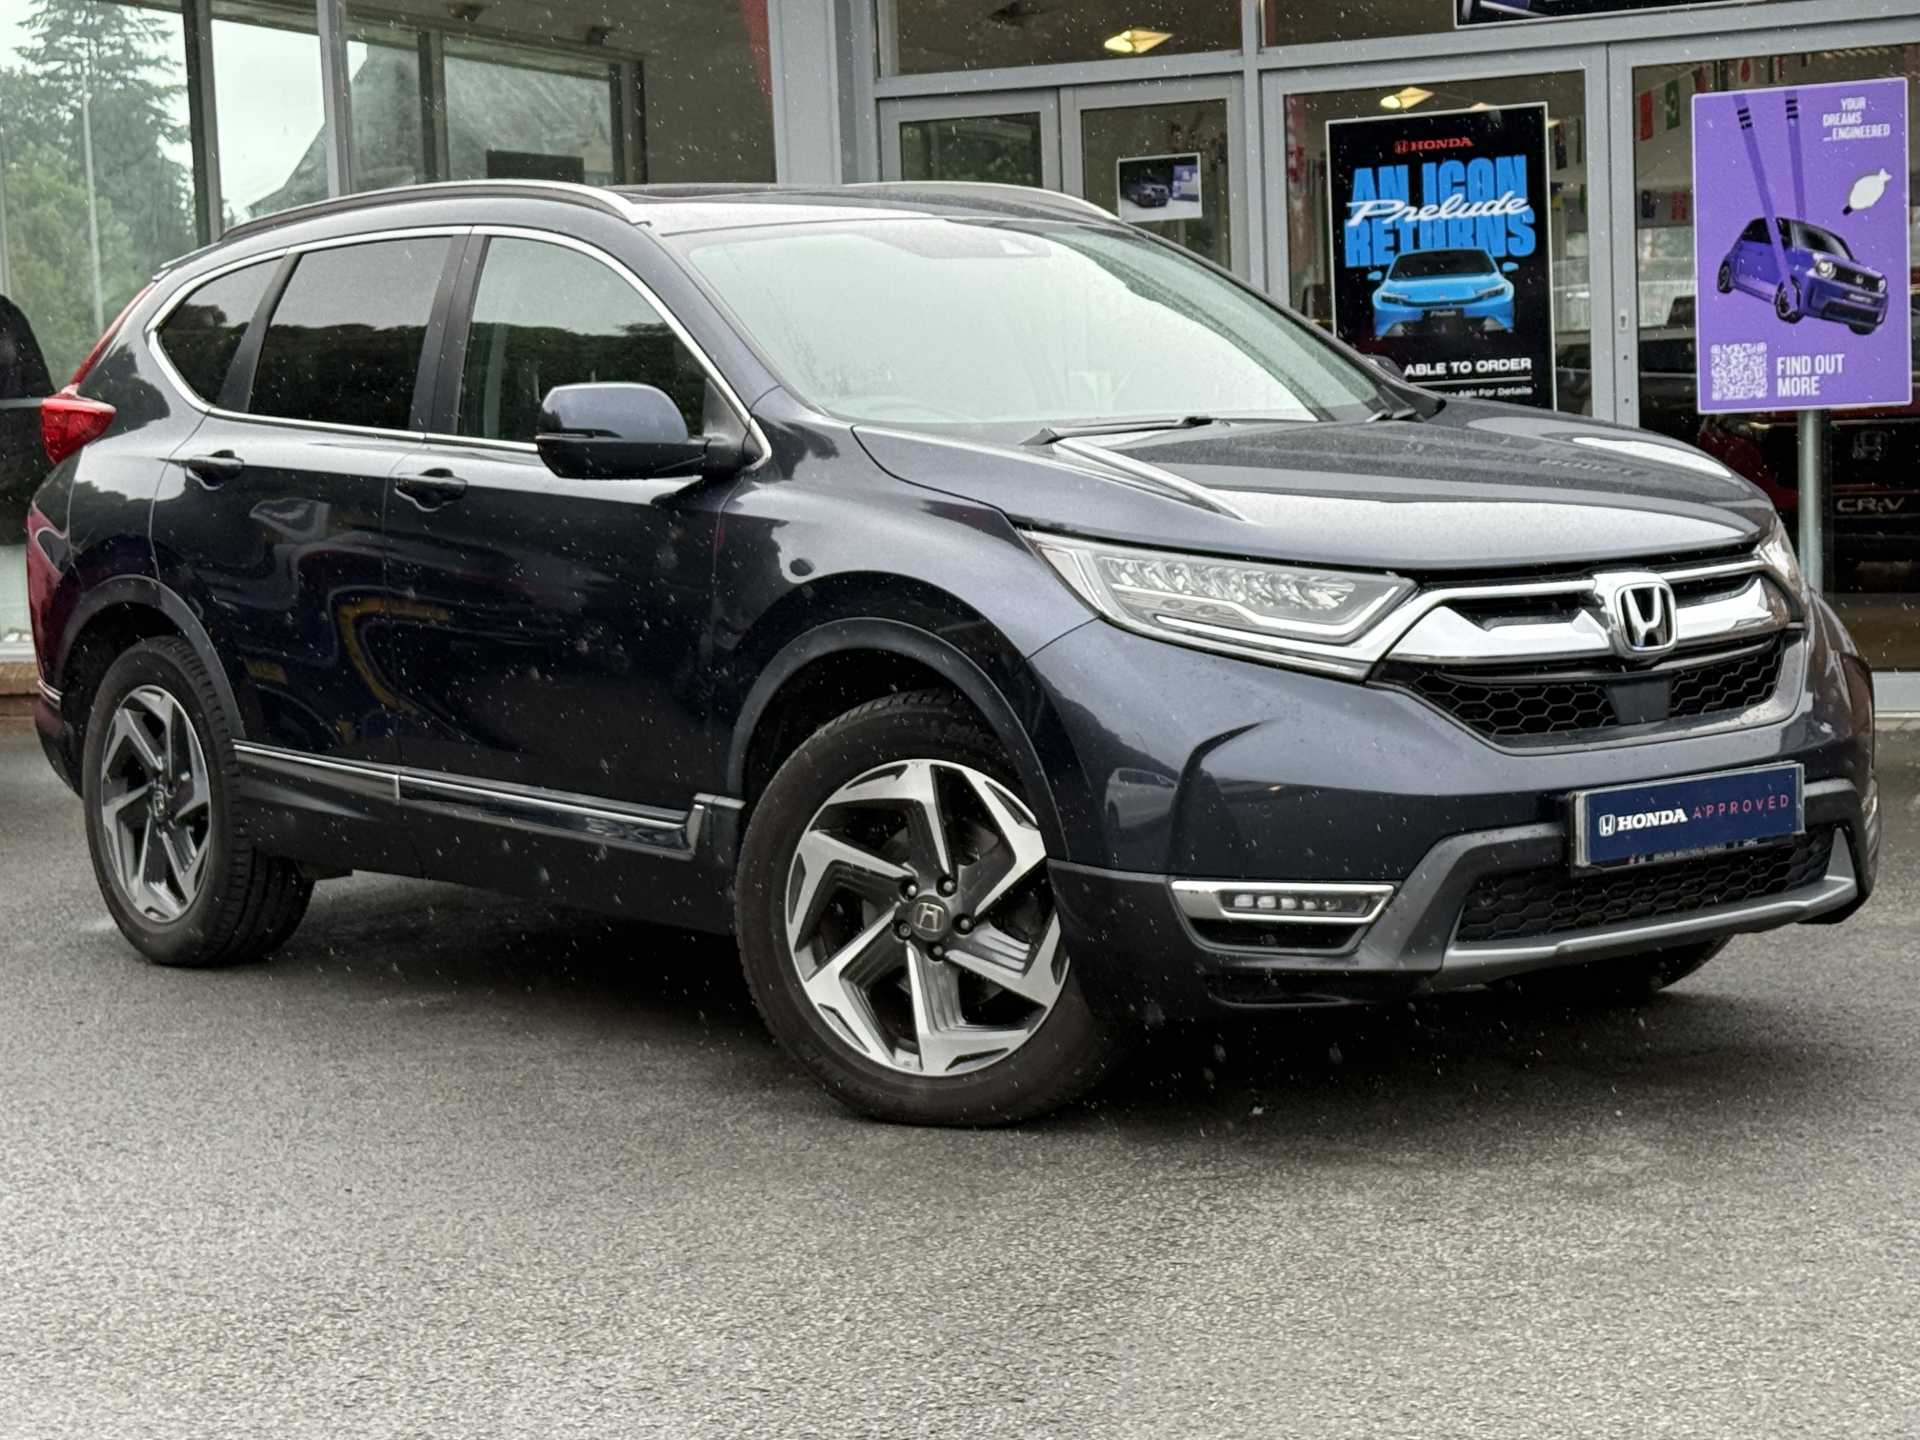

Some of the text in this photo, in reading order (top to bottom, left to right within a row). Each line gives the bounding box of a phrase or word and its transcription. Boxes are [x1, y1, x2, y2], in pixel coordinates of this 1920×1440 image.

[1410, 136, 1474, 151] HONDA
[1422, 154, 1527, 204] ICON
[1346, 190, 1531, 227] Prelude
[1344, 206, 1536, 268] RETURNS
[1450, 360, 1473, 374] TO
[1475, 357, 1532, 373] ORDER
[1776, 353, 1846, 376] FIND OUT
[1777, 376, 1821, 398] MORE
[1616, 807, 1689, 832] HONDA
[1692, 794, 1790, 820] APPROVED
